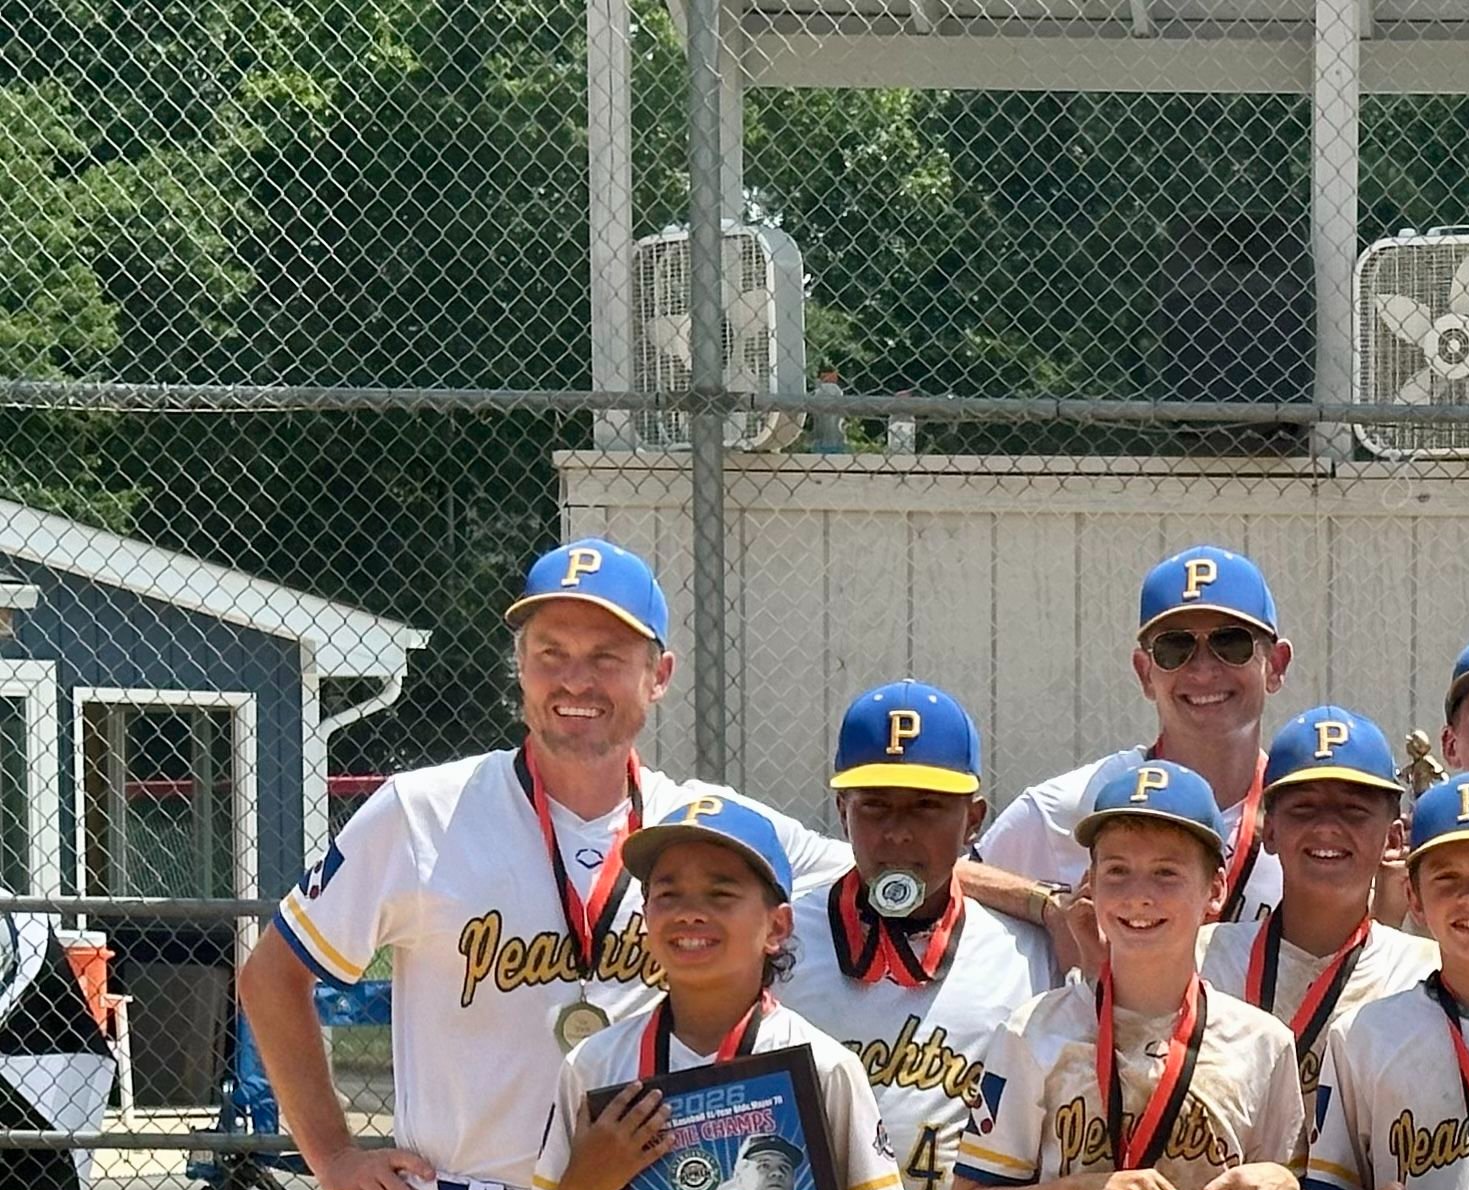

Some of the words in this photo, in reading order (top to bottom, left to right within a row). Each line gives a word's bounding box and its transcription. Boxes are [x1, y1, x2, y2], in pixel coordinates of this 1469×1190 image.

[561, 548, 602, 588] P
[1181, 559, 1218, 600] P
[886, 709, 921, 755] P
[1314, 720, 1350, 761] P
[1129, 766, 1168, 803] P
[683, 795, 724, 826] P
[701, 1107, 777, 1142] CHAMPS
